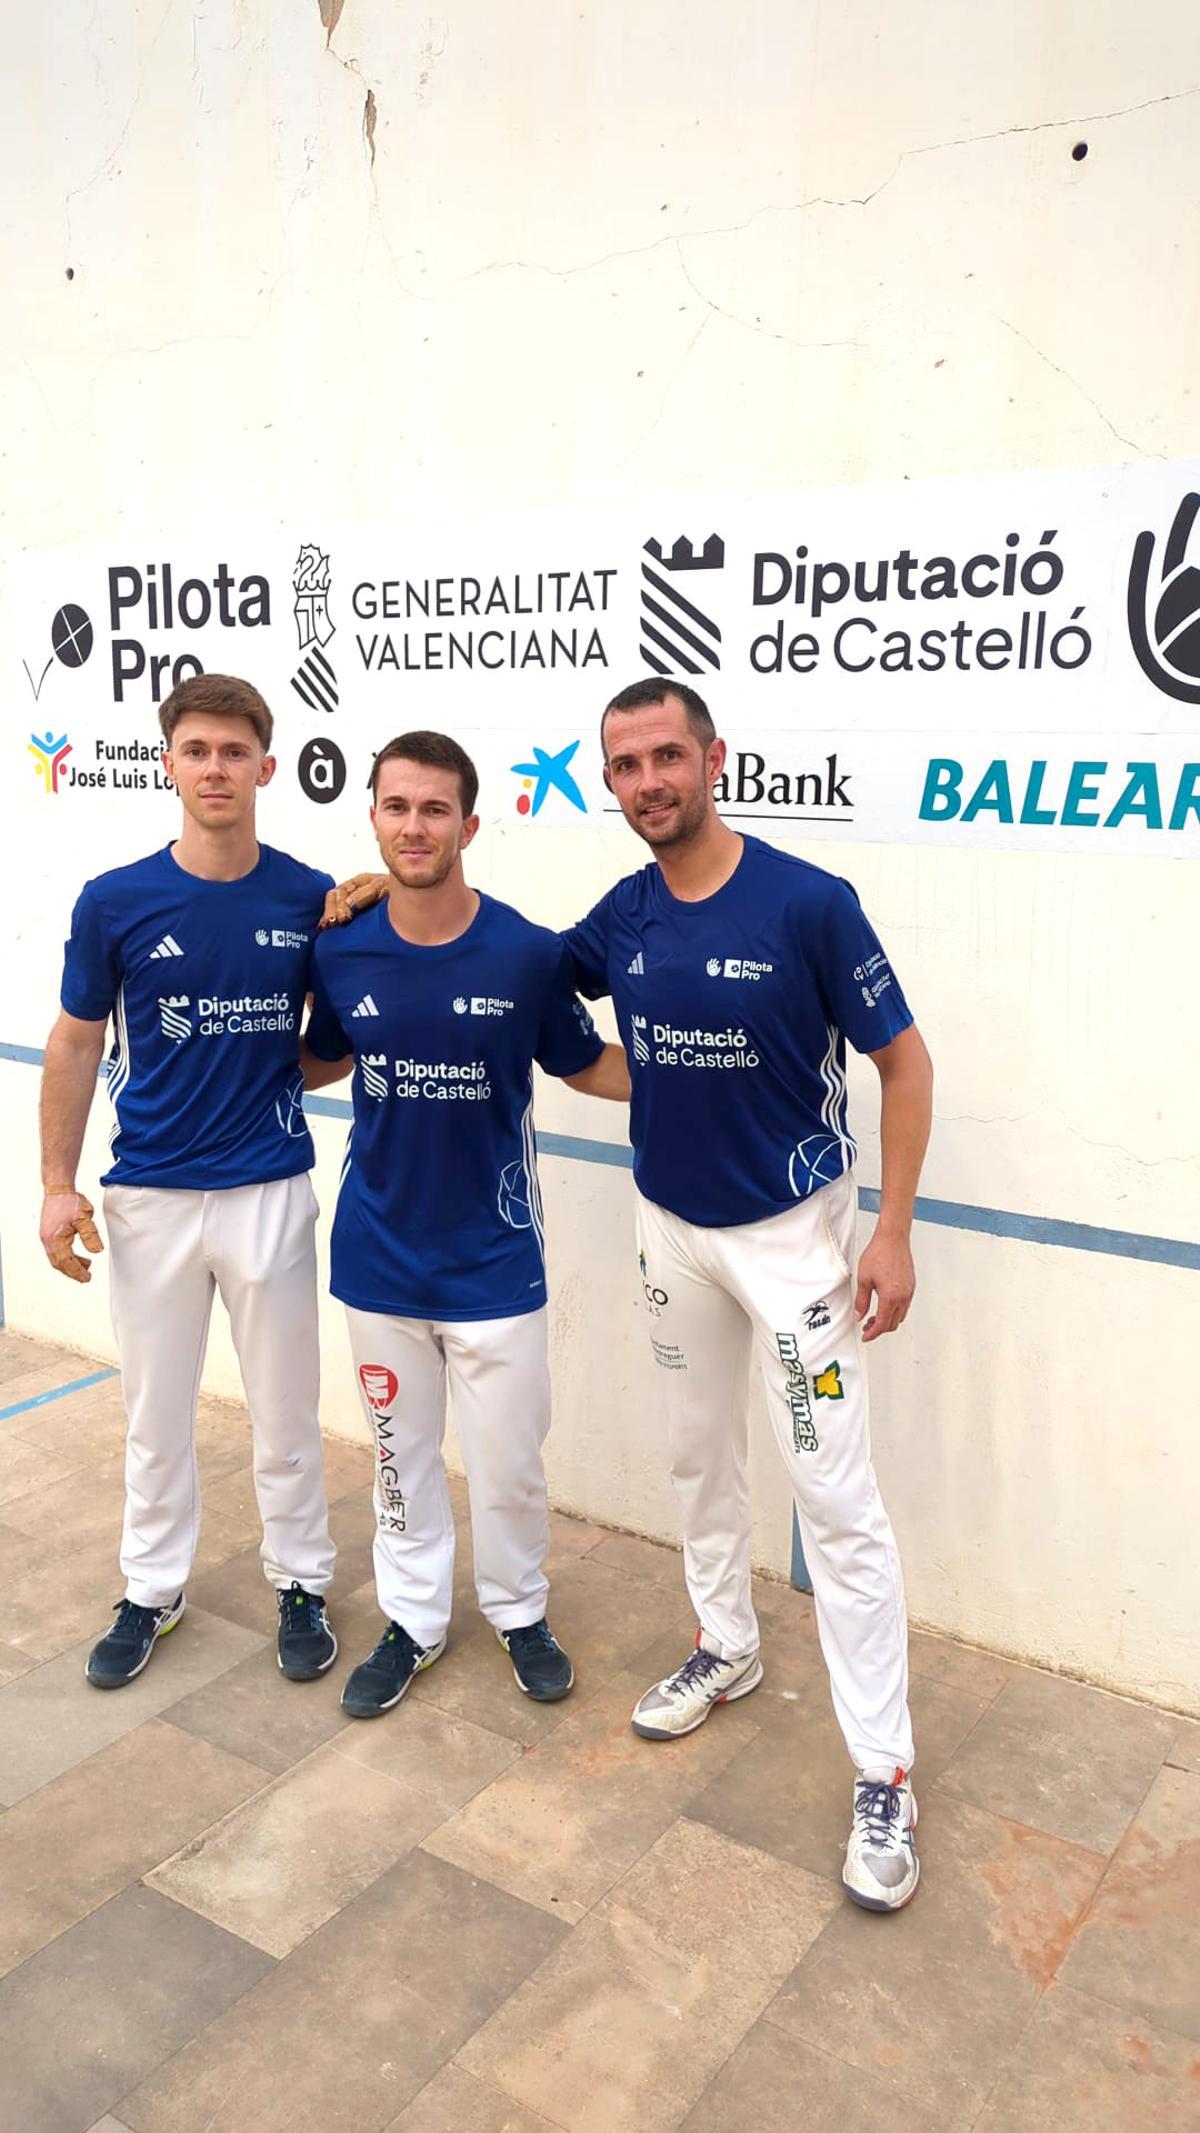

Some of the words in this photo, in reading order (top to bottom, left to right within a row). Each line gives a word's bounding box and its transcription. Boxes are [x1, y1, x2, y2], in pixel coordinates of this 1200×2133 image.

[752, 529, 1064, 618] Diputació
[109, 563, 271, 631] Pilota
[352, 569, 618, 619] GENERALITAT
[355, 627, 609, 671] VALENCIANA
[749, 619, 820, 674] de
[833, 606, 1092, 673] Castelló
[95, 739, 171, 761] Fundaci
[69, 766, 106, 788] José
[113, 768, 147, 789] Luis
[286, 931, 308, 942] Pilota
[286, 940, 301, 949] Pro
[741, 969, 760, 980] Pro
[742, 960, 773, 972] Pilota
[198, 993, 289, 1018] Diputació
[487, 998, 514, 1009] Pilota
[487, 1007, 503, 1017] Pro
[200, 1018, 224, 1035] de
[227, 1013, 294, 1033] Castelló
[653, 1023, 748, 1049] Diputació
[656, 1046, 678, 1065] de
[680, 1048, 760, 1069] Castelló
[395, 1058, 486, 1082] Diputació
[396, 1080, 419, 1098] de
[422, 1080, 491, 1101] Castelló
[374, 1412, 406, 1532] MAGBER
